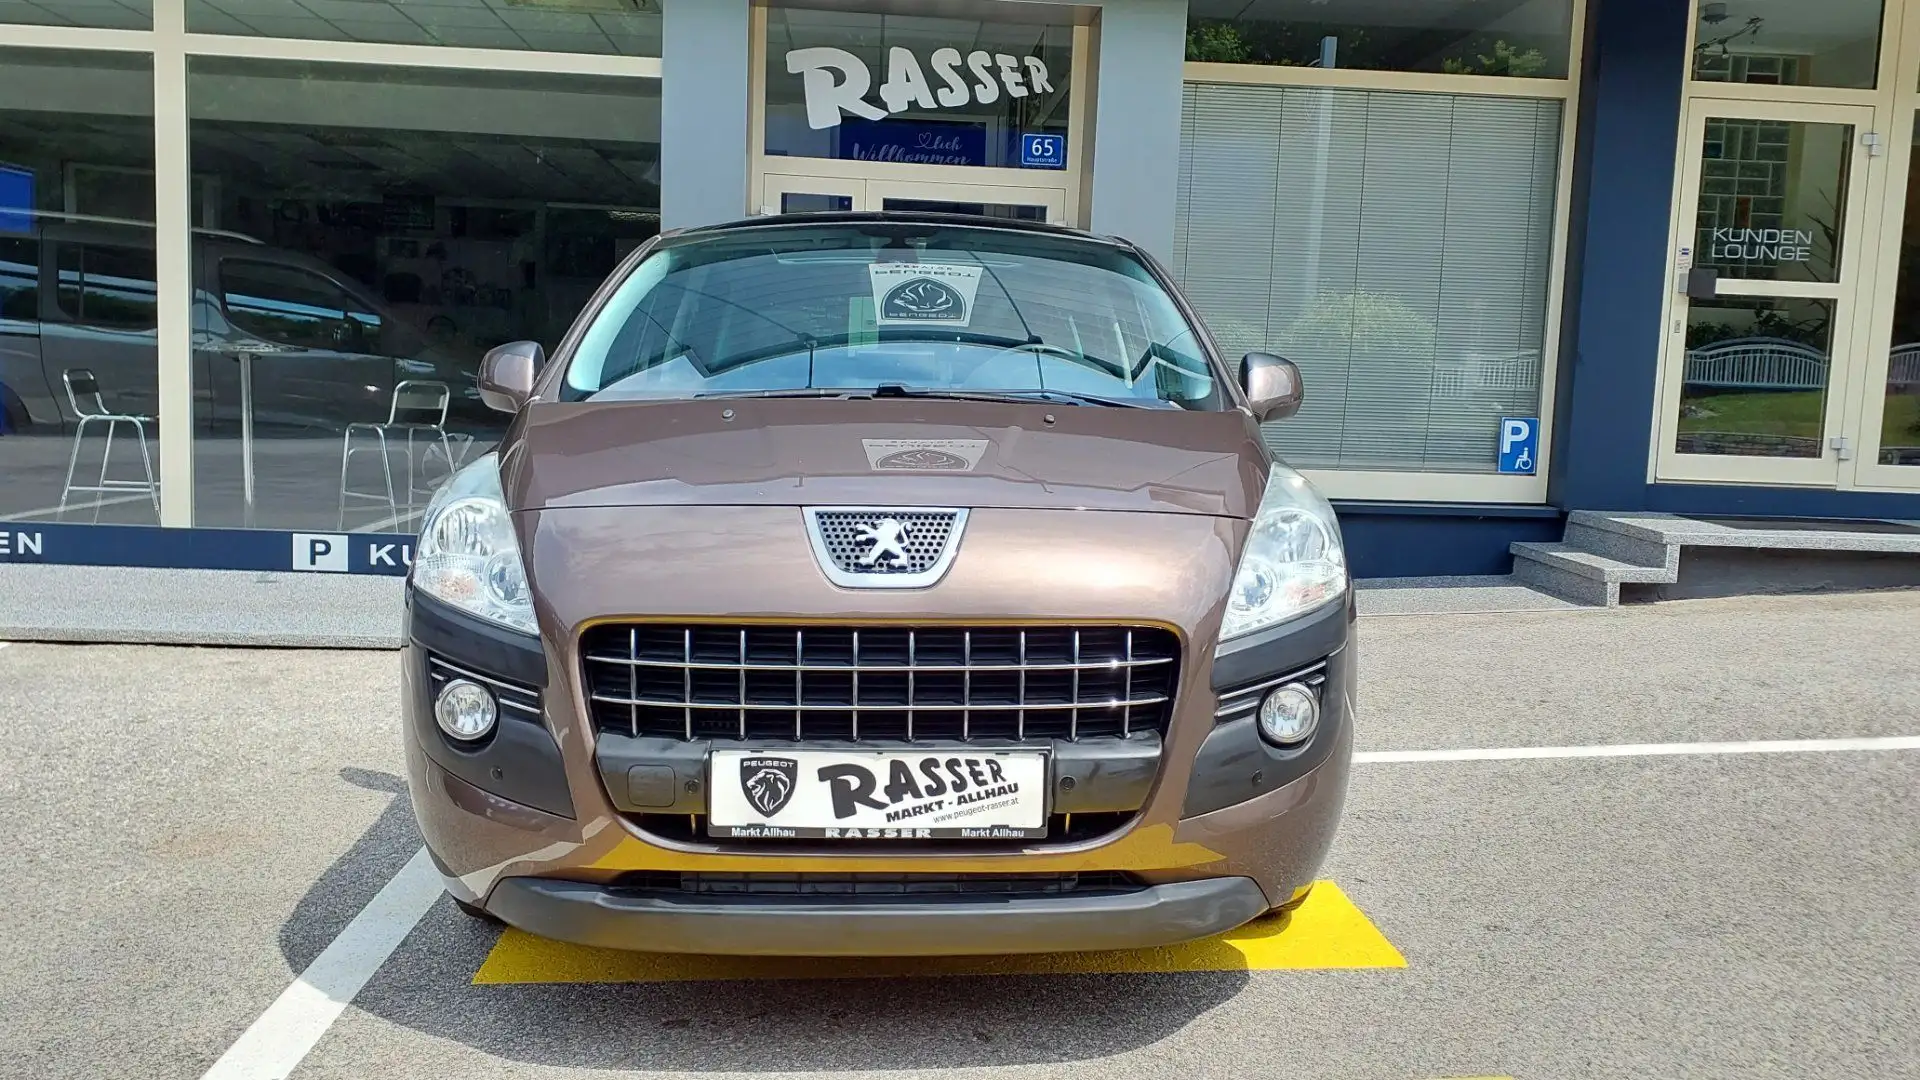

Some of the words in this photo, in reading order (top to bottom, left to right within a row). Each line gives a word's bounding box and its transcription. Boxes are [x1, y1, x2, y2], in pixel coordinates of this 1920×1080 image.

[785, 46, 1054, 130] RASSER
[1031, 138, 1054, 157] 65
[1712, 227, 1812, 245] KUNDEN
[1711, 244, 1811, 262] LOUNGE
[1502, 420, 1530, 454] P
[309, 539, 332, 566] P
[743, 760, 794, 768] PEUGEOT
[818, 758, 1007, 820] RASSER
[886, 802, 944, 823] MARKT
[956, 783, 1020, 806] ALLHAU
[933, 796, 1019, 824] www.peugeot-rasser.at
[731, 827, 761, 838] Markt
[763, 827, 796, 838] Allhau
[825, 828, 933, 838] RASSER
[962, 828, 989, 838] Markt
[991, 828, 1025, 838] Allhau
